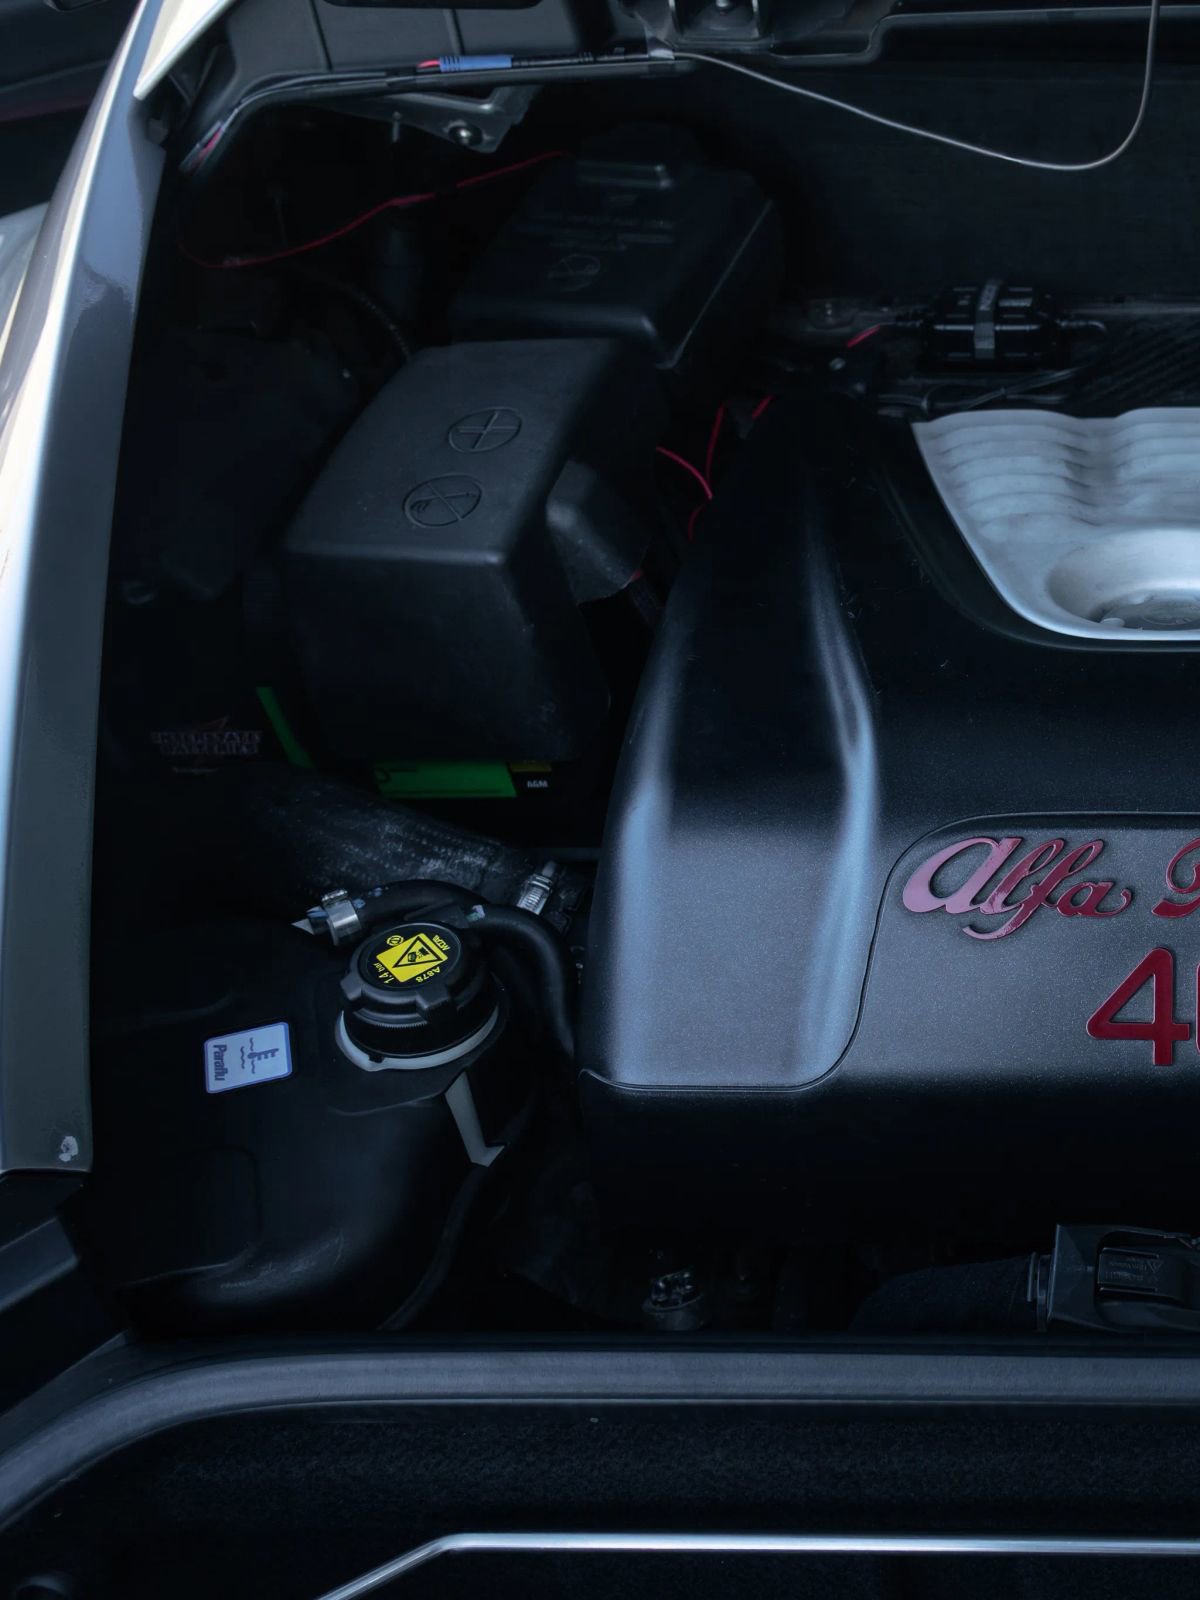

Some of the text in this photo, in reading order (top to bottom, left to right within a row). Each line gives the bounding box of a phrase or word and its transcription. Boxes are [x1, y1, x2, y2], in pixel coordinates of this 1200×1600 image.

[902, 835, 1132, 941] Alfa
[373, 962, 386, 973] bar
[415, 966, 441, 983] A878
[213, 1044, 229, 1081] Paraflu
